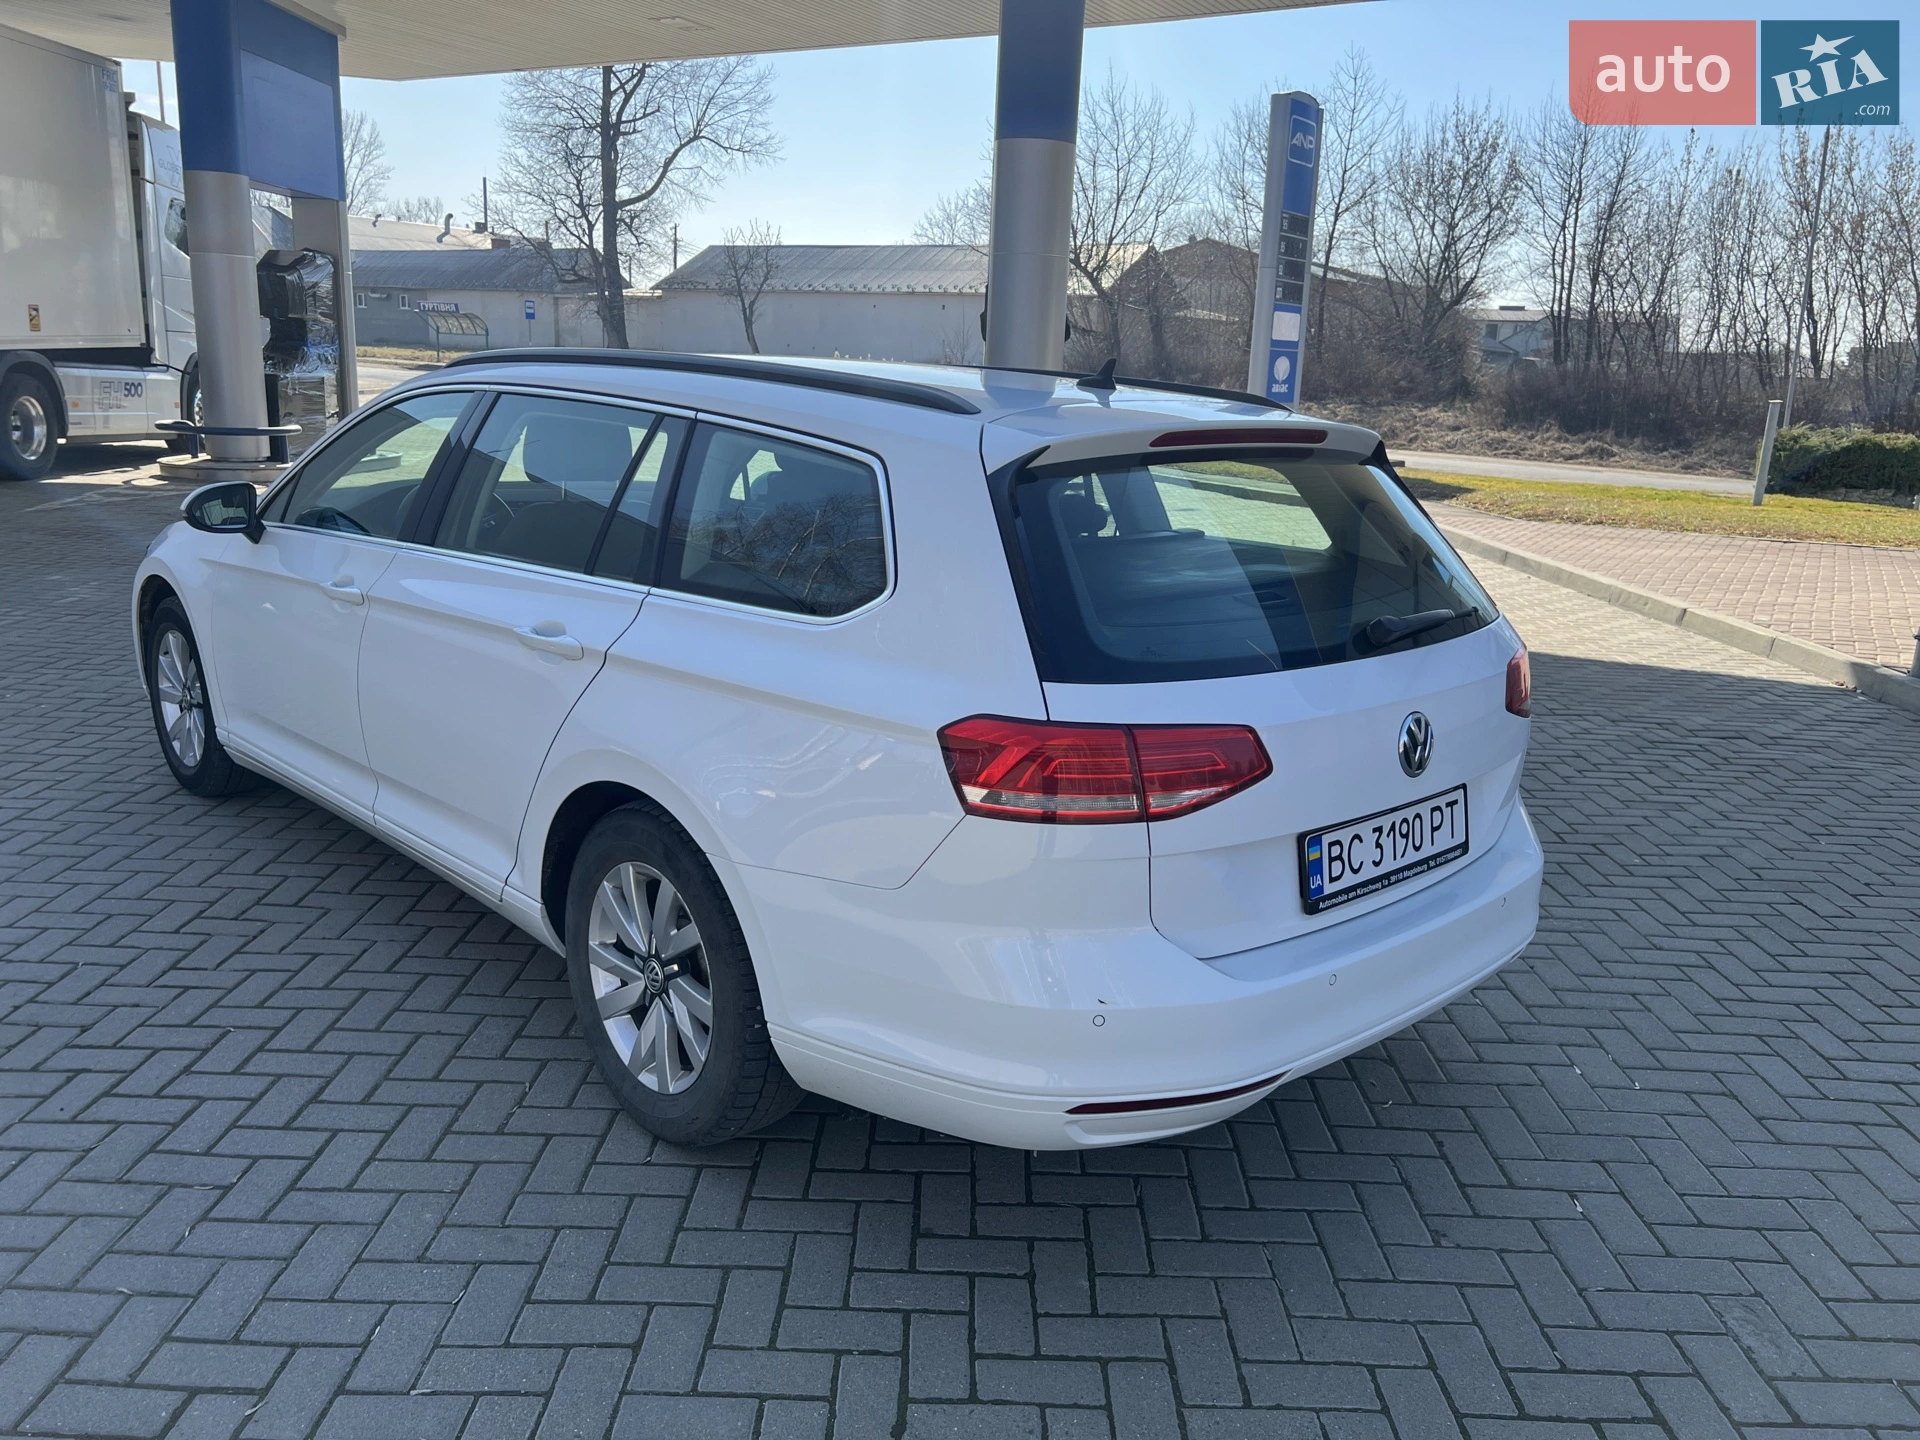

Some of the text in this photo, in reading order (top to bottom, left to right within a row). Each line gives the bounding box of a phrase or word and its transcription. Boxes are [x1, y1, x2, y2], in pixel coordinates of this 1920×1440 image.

[123, 382, 143, 398] 500
[1328, 799, 1459, 884] BC 3190 PT
[1310, 874, 1322, 889] UA
[1319, 894, 1348, 909] Automobile
